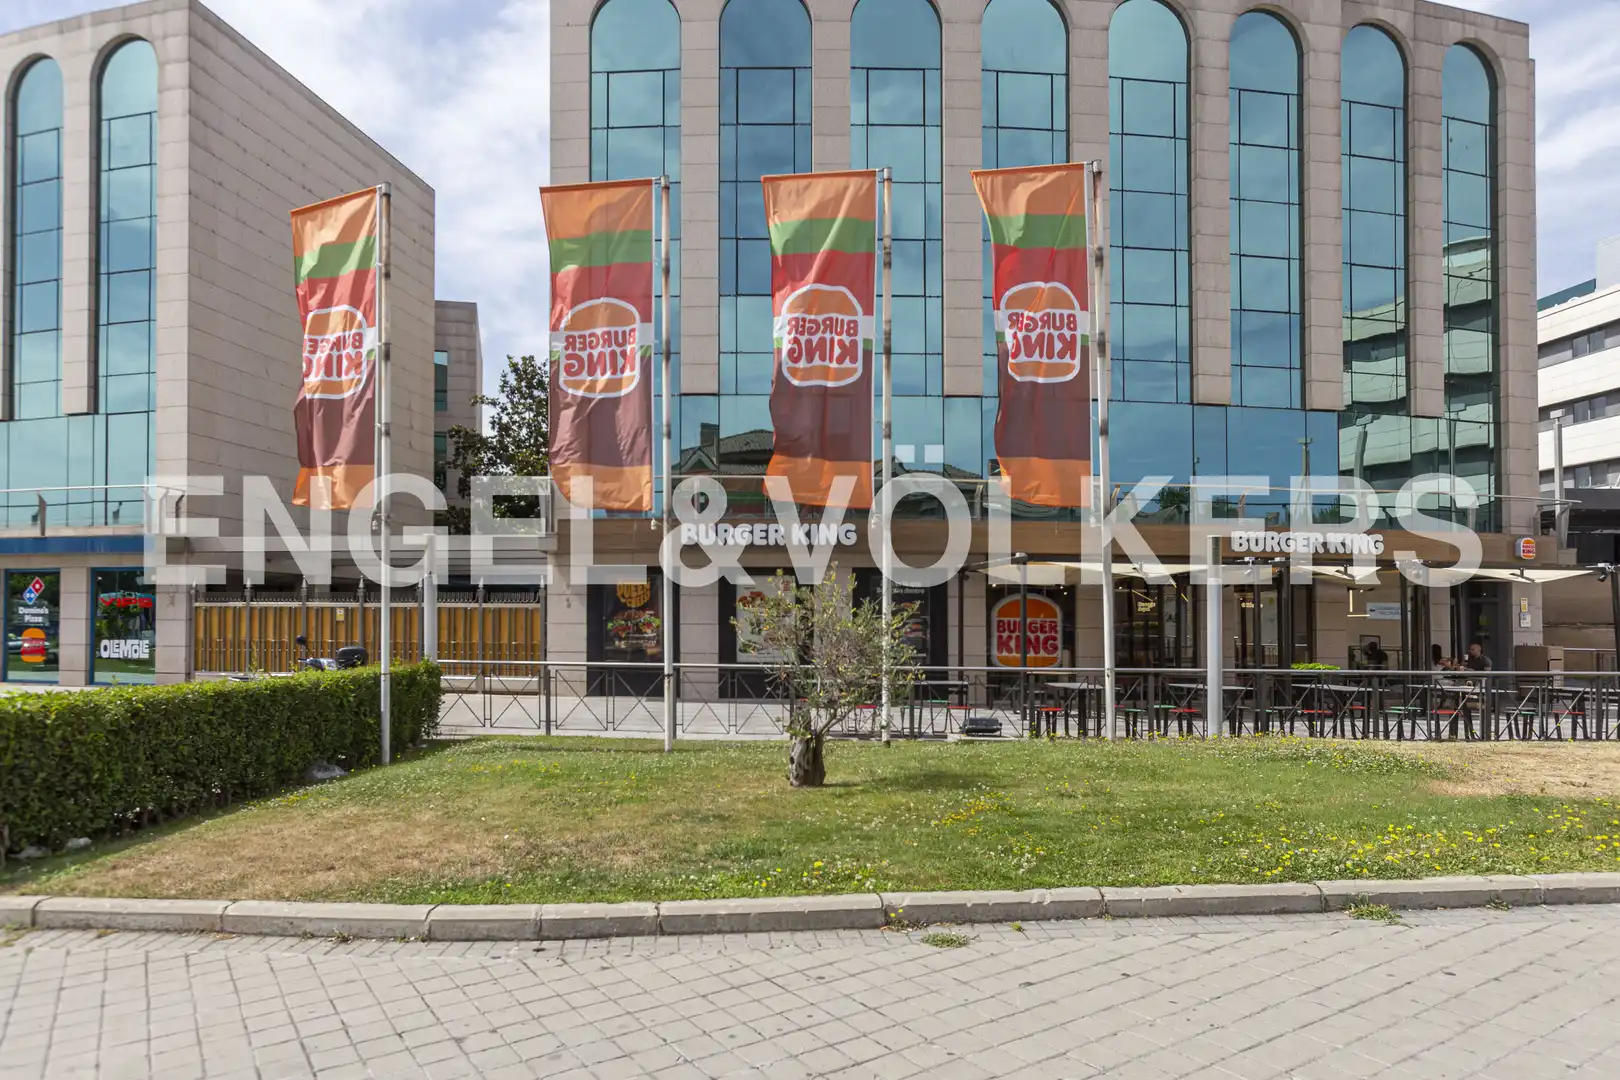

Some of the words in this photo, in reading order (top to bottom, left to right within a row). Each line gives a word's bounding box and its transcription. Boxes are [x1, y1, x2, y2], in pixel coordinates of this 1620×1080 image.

[680, 522, 785, 546] BURGER
[790, 522, 858, 546] KING
[1231, 531, 1324, 553] BURGER
[1325, 533, 1385, 555] KING
[18, 606, 49, 615] Domino's
[997, 634, 1059, 655] KING
